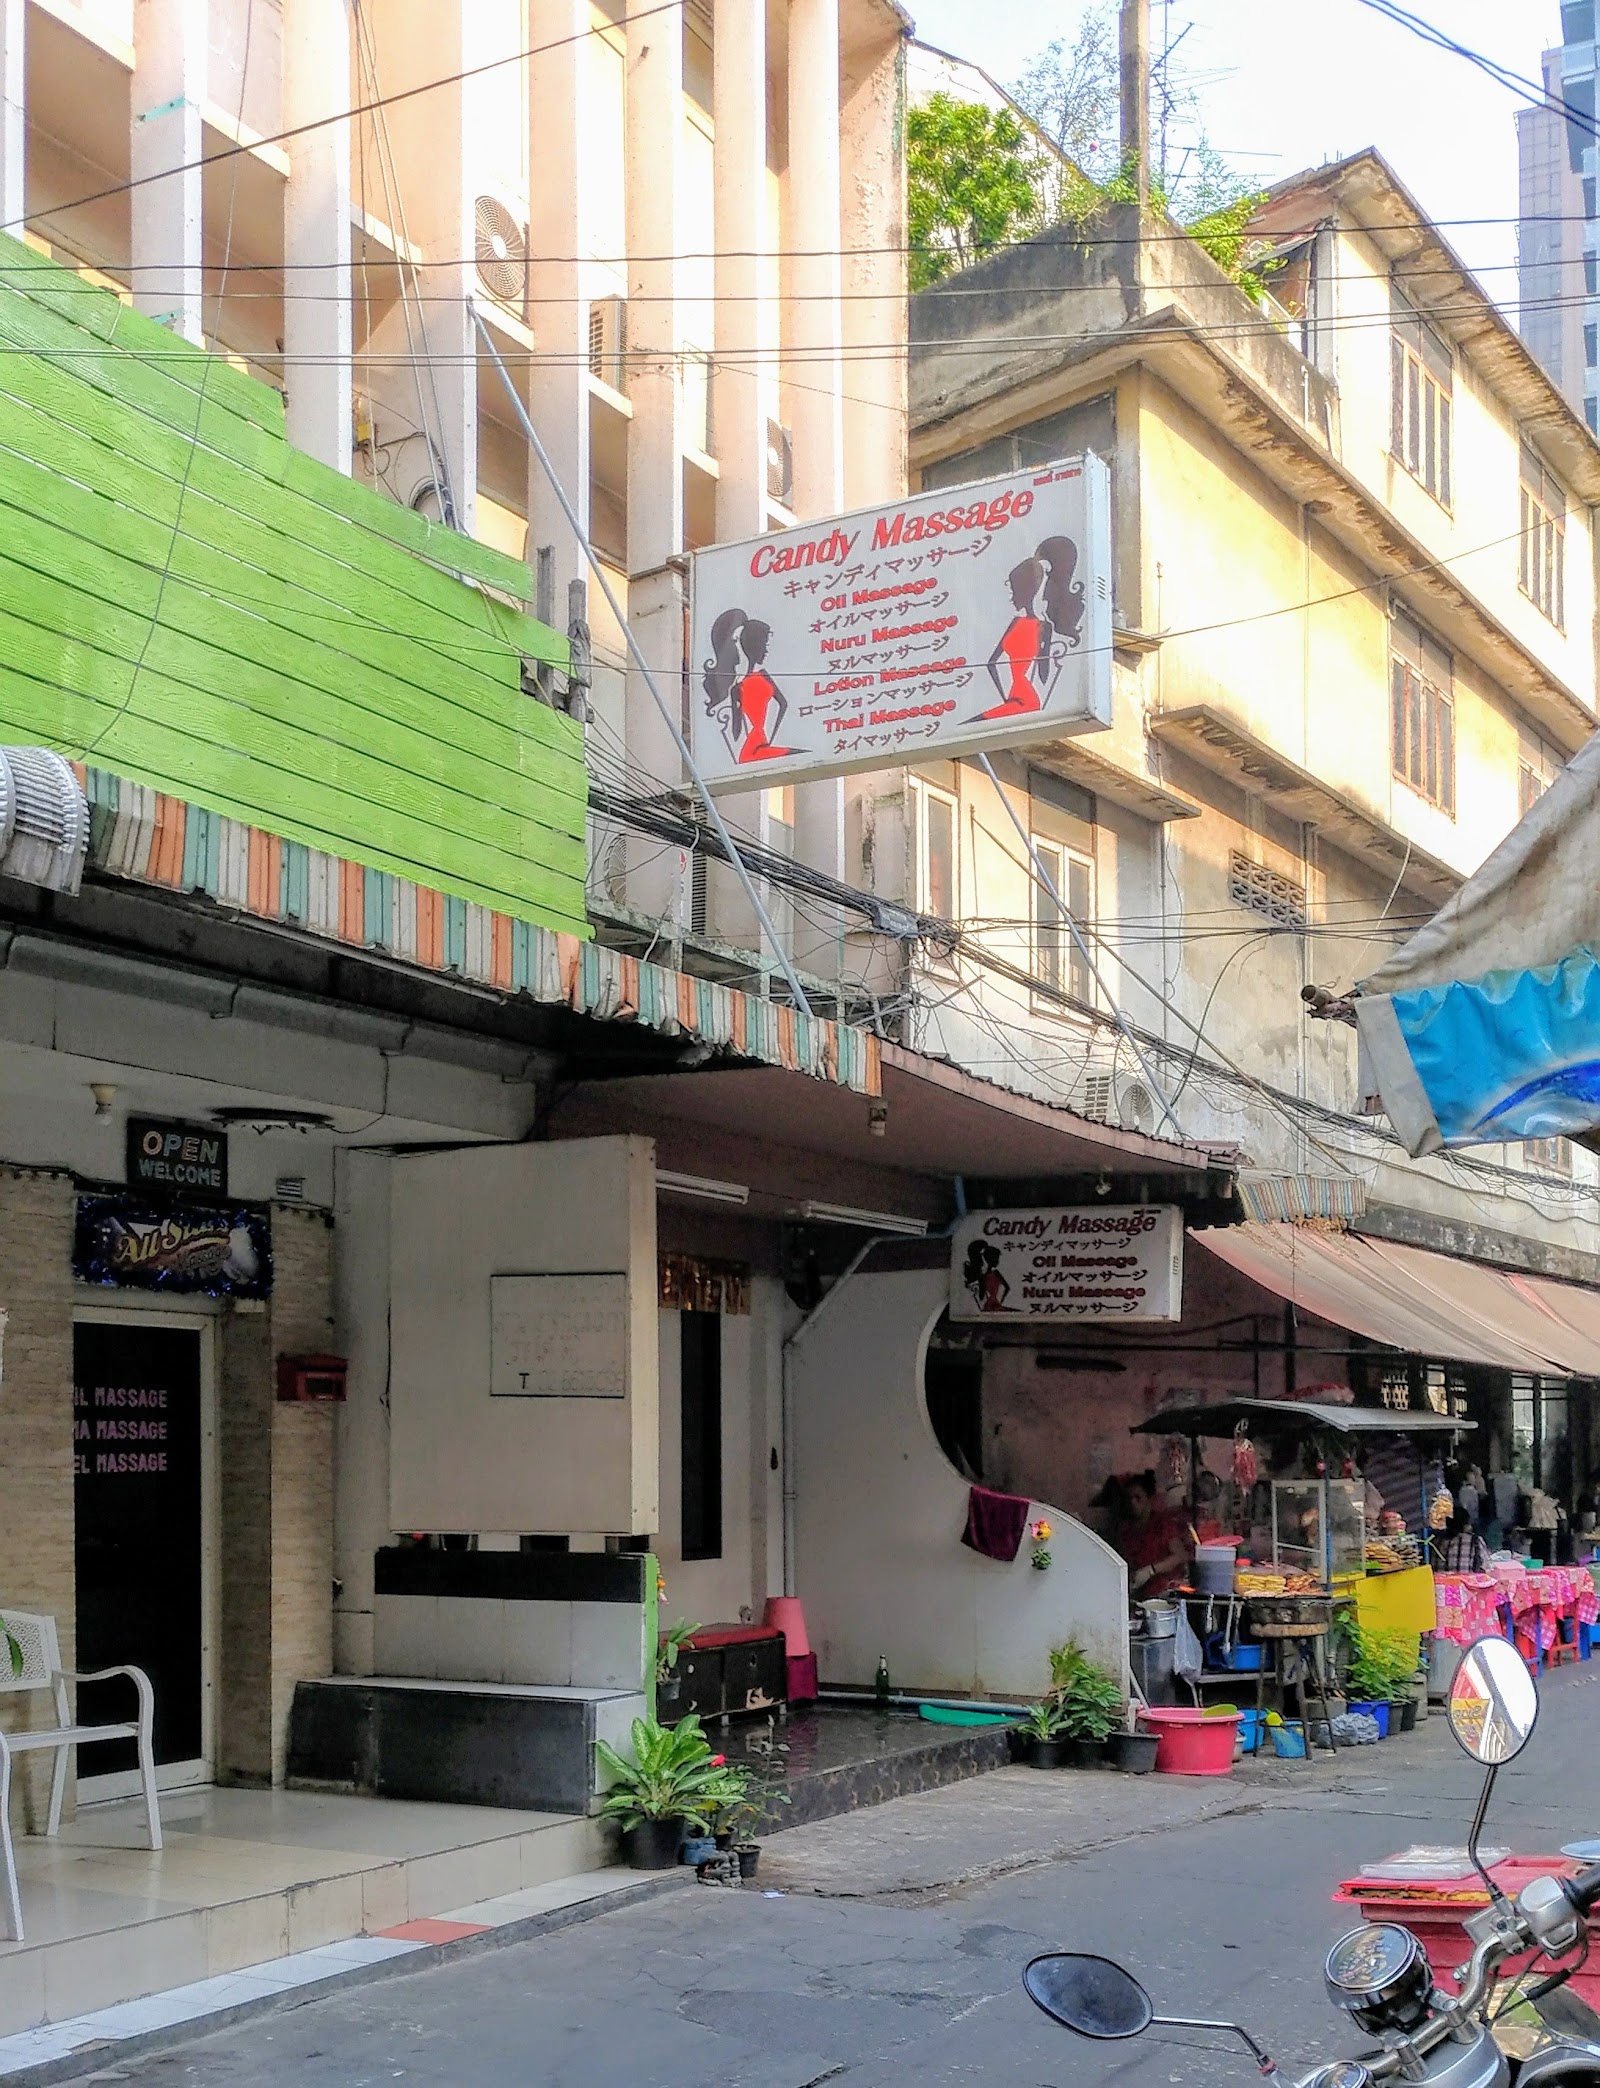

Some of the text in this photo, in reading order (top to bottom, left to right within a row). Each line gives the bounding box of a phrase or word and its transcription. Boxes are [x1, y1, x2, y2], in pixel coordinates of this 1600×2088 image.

[750, 489, 1034, 578] Candy Massage
[783, 535, 993, 599] キャンディマッサージ
[820, 577, 938, 612] Oil Massage
[809, 591, 950, 634] オイルマッサージ
[820, 615, 959, 654] Nuru Massage
[828, 635, 950, 673] ヌルマッサージ
[813, 656, 968, 696] Lotion Massage
[798, 672, 974, 717] ローションマッサージ
[823, 699, 957, 734] Thai Massage
[834, 720, 941, 754] タイマッサージ
[142, 1130, 219, 1165] OPEN
[138, 1158, 221, 1188] WELCOME
[983, 1215, 1156, 1238] Candy Massage
[113, 1231, 160, 1264] All
[1003, 1237, 1131, 1252] キャンディマッサージ
[1032, 1255, 1138, 1268] Oil Massage
[1021, 1269, 1148, 1284] オイルマッサージ
[1023, 1286, 1146, 1299] Nuru Massage
[95, 1387, 168, 1408] MASSAGE
[96, 1420, 168, 1440] MASSAGE
[96, 1452, 168, 1474] MASSAGE
